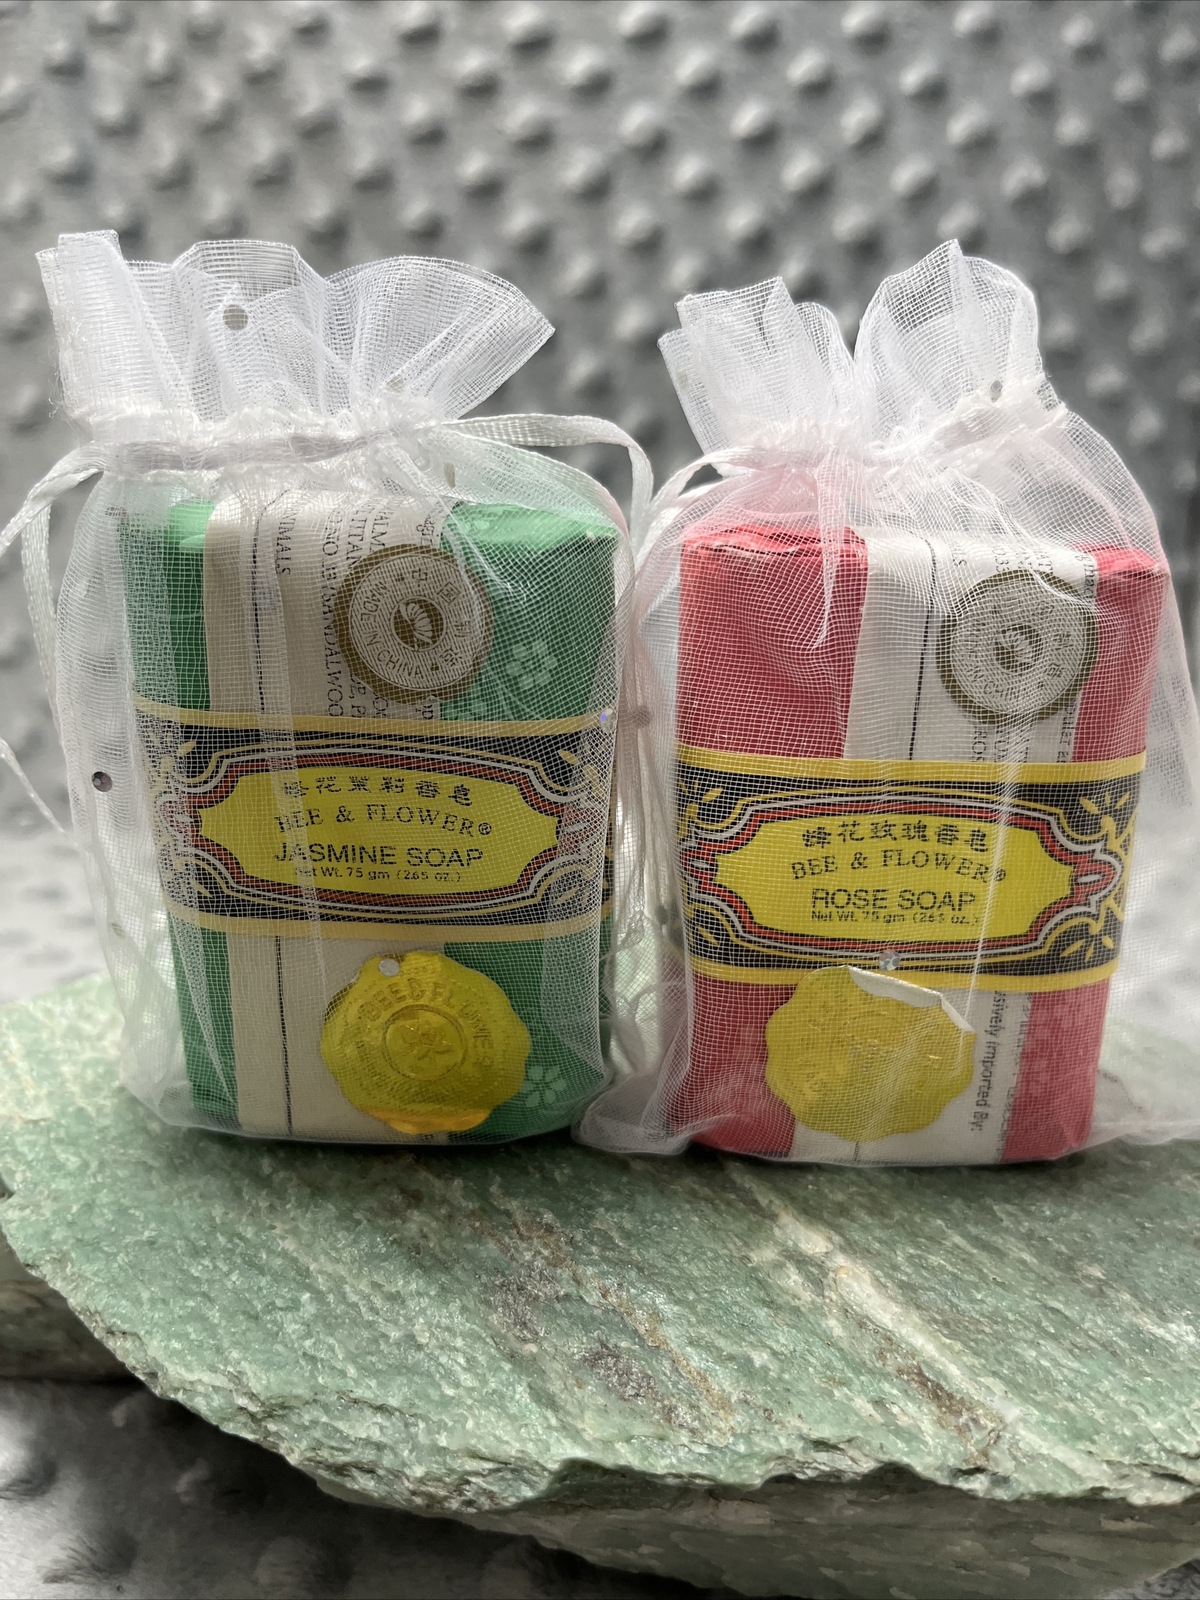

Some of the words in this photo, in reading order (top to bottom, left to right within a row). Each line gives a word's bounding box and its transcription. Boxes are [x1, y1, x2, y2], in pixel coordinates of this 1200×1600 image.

[360, 580, 391, 623] MADE
[363, 628, 382, 646] IN
[321, 585, 344, 718] (SANDALWOO
[377, 649, 425, 680] CHINA
[274, 808, 324, 833] BEE
[336, 805, 355, 823] &
[802, 819, 989, 852] 蜂花玫瑰香皂
[275, 842, 397, 865] JASMINE
[406, 847, 484, 868] SOAP
[791, 855, 838, 880] BEE
[850, 851, 868, 870] &
[346, 866, 364, 879] 75
[368, 870, 390, 881] gm
[811, 888, 889, 909] ROSE
[897, 889, 976, 911] SOAP
[811, 910, 833, 922] Net
[883, 913, 905, 924] gm
[984, 990, 1008, 1036] sively
